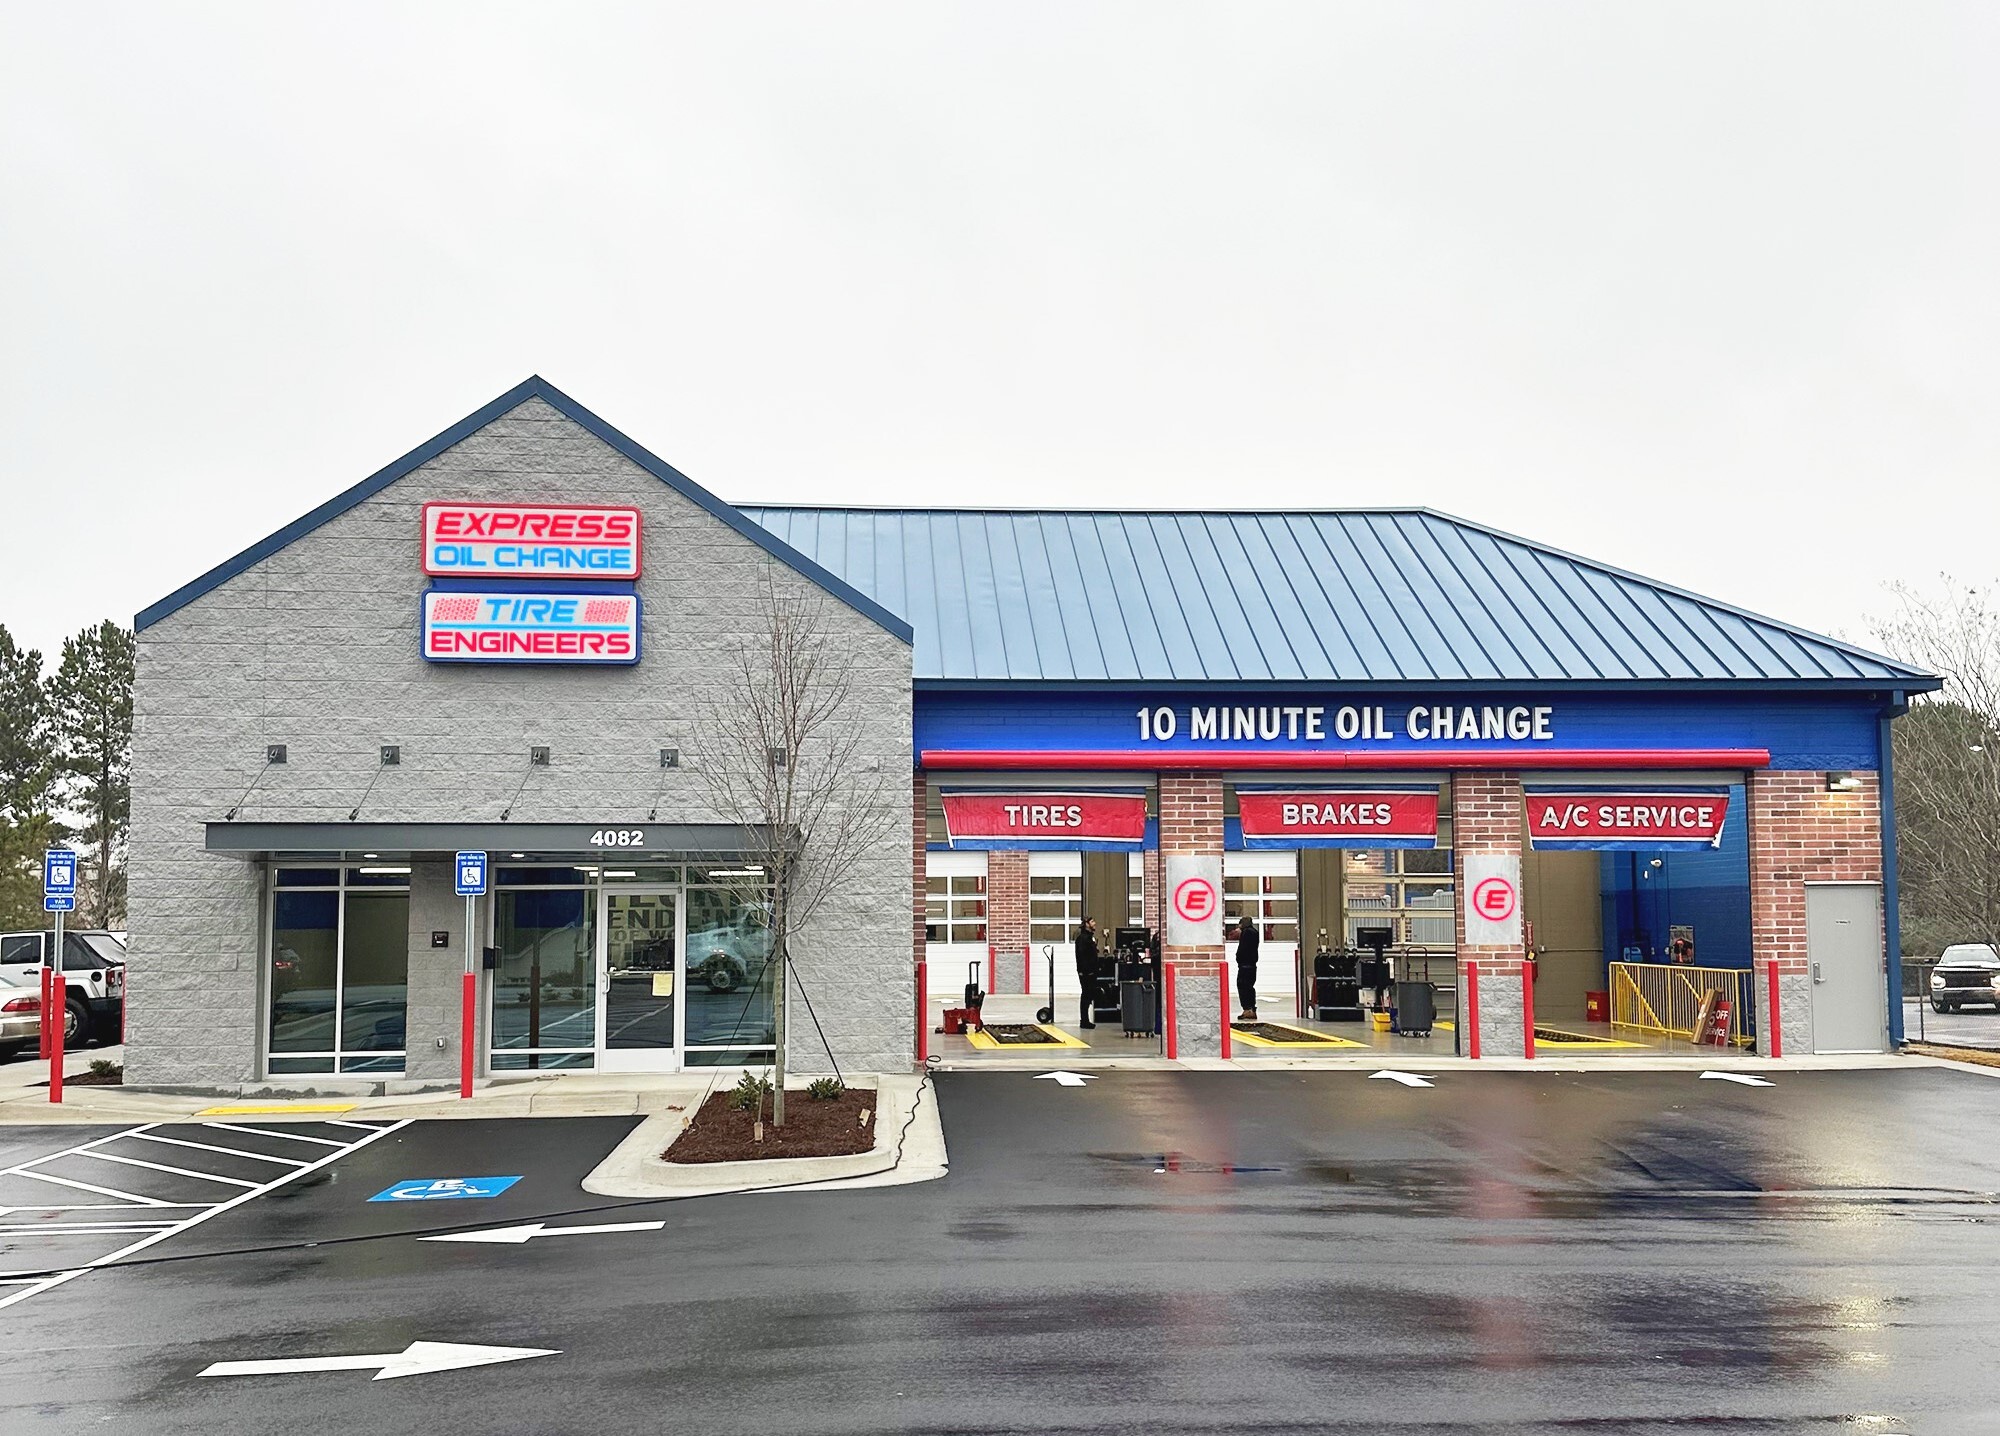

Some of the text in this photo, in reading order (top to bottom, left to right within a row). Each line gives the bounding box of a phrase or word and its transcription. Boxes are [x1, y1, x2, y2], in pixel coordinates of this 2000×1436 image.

[435, 511, 633, 538] EXPRESS
[433, 545, 631, 569] OIL CHANGE
[485, 599, 579, 623] TIRE
[430, 631, 631, 655] ENGINEERS
[1136, 706, 1554, 741] 10 MINUTE OIL CHANGE
[1004, 805, 1083, 827] TIRES
[1281, 803, 1393, 826] BRAKES
[1540, 804, 1714, 830] A/C SERVICE
[589, 829, 645, 847] 4082
[1185, 890, 1209, 910] E
[1484, 889, 1508, 909] E
[1715, 1010, 1728, 1020] OFF
